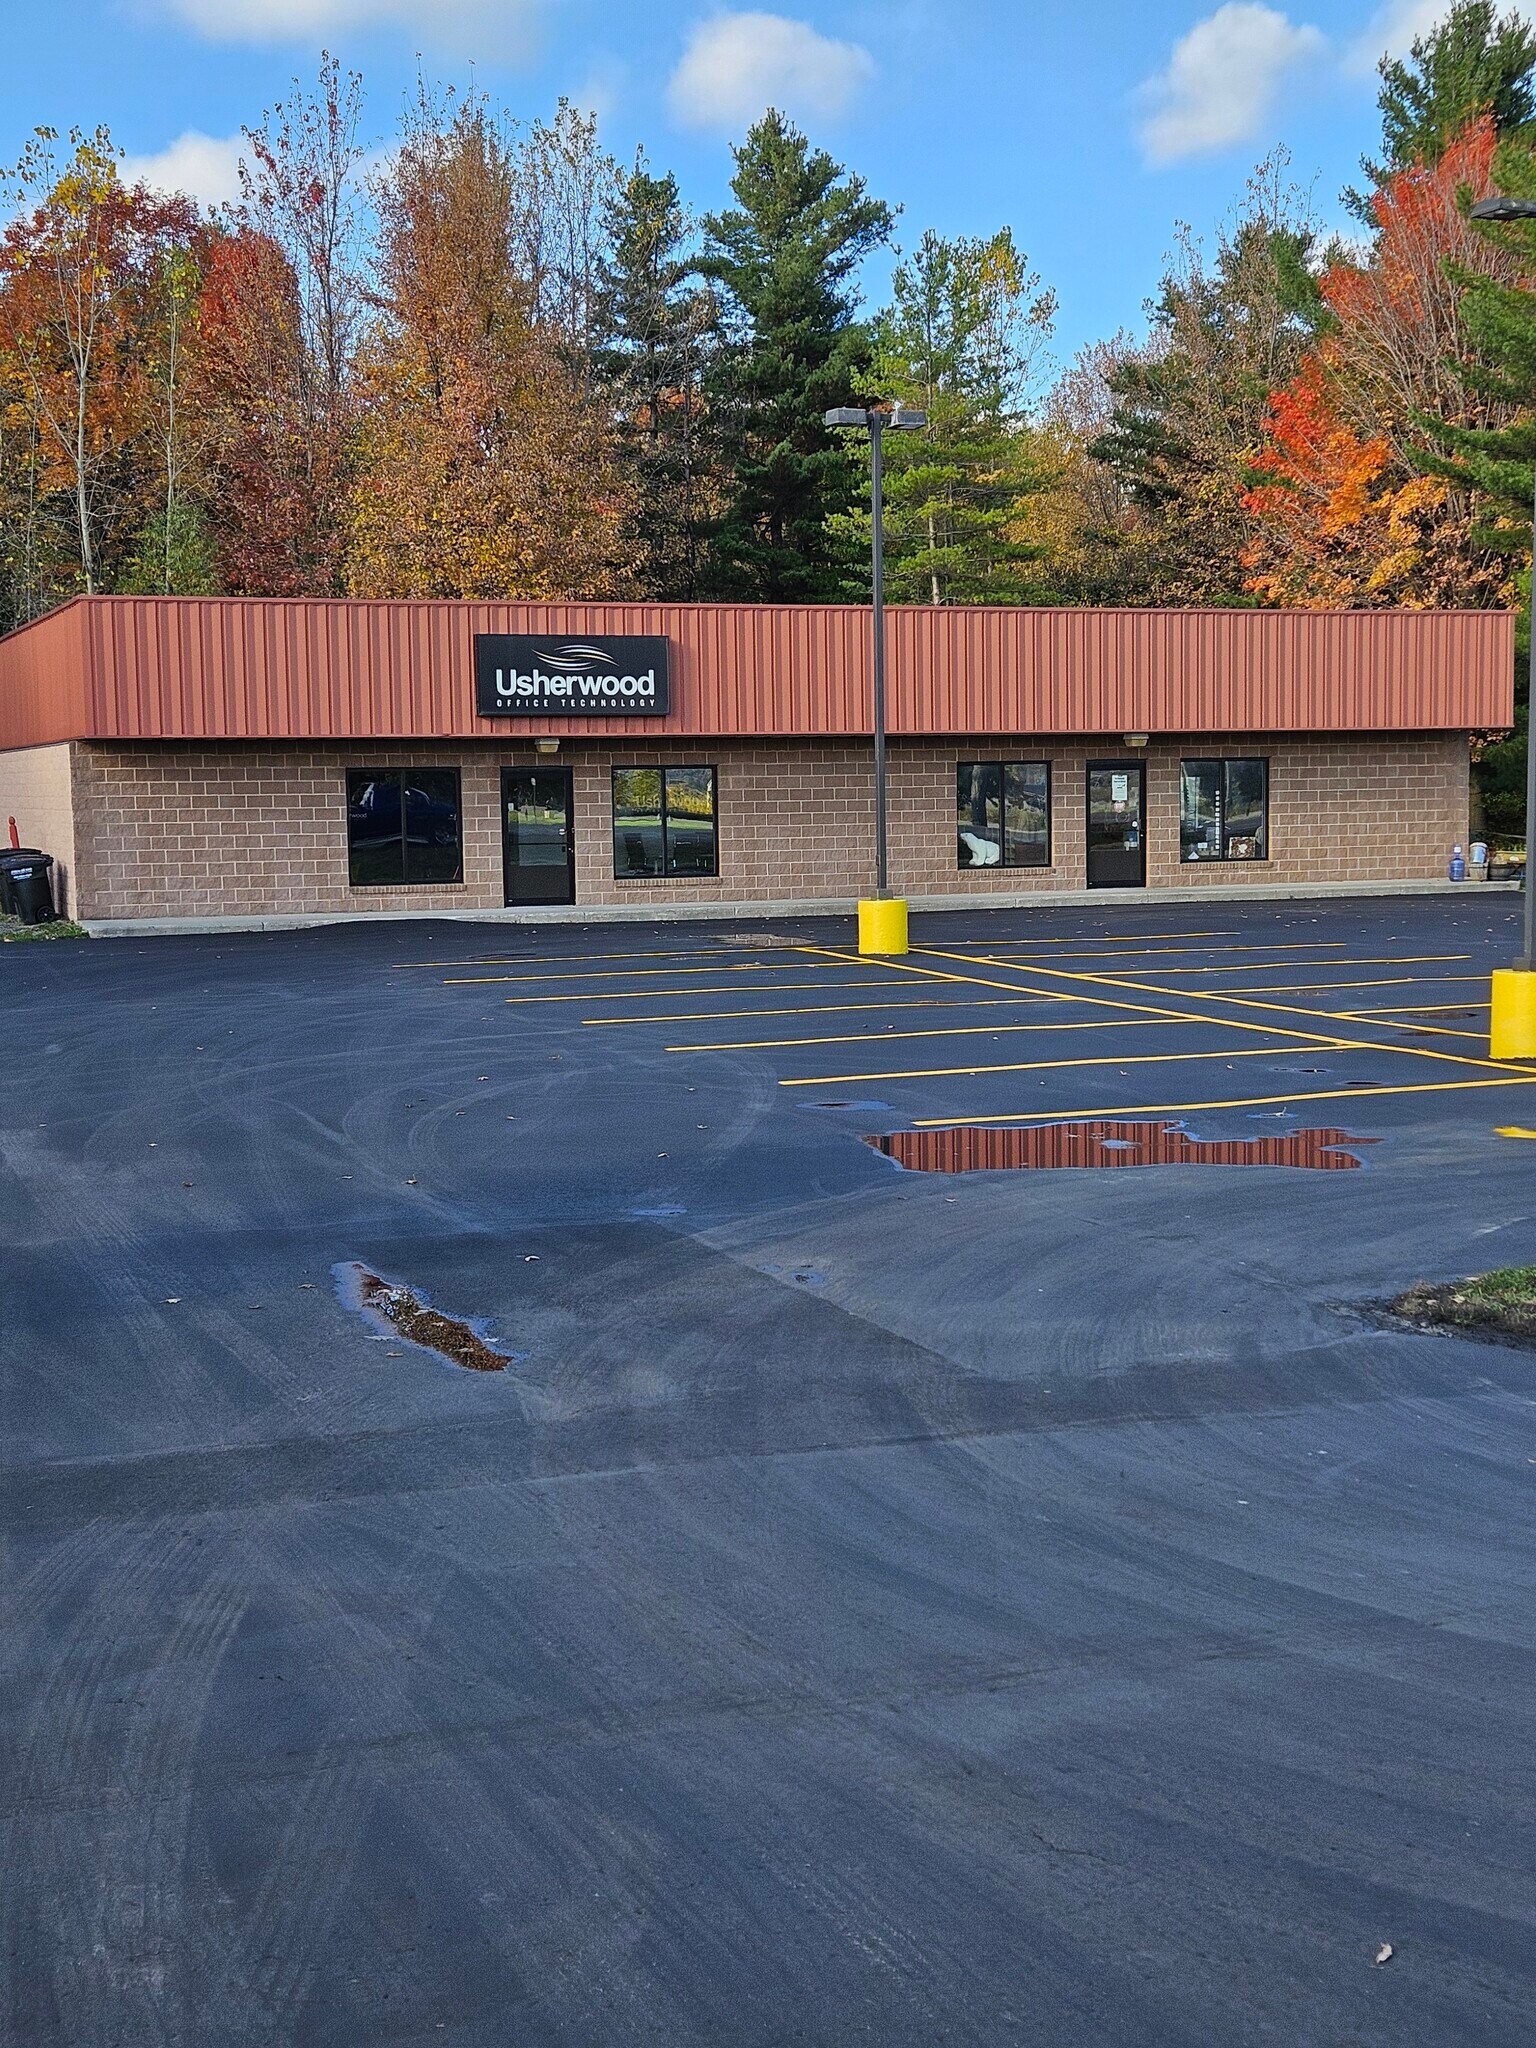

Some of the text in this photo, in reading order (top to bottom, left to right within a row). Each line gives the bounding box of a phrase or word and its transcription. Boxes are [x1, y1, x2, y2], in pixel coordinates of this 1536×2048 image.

[495, 668, 655, 696] Usherwood
[496, 699, 655, 707] OFFICE TECHNOLOGY
